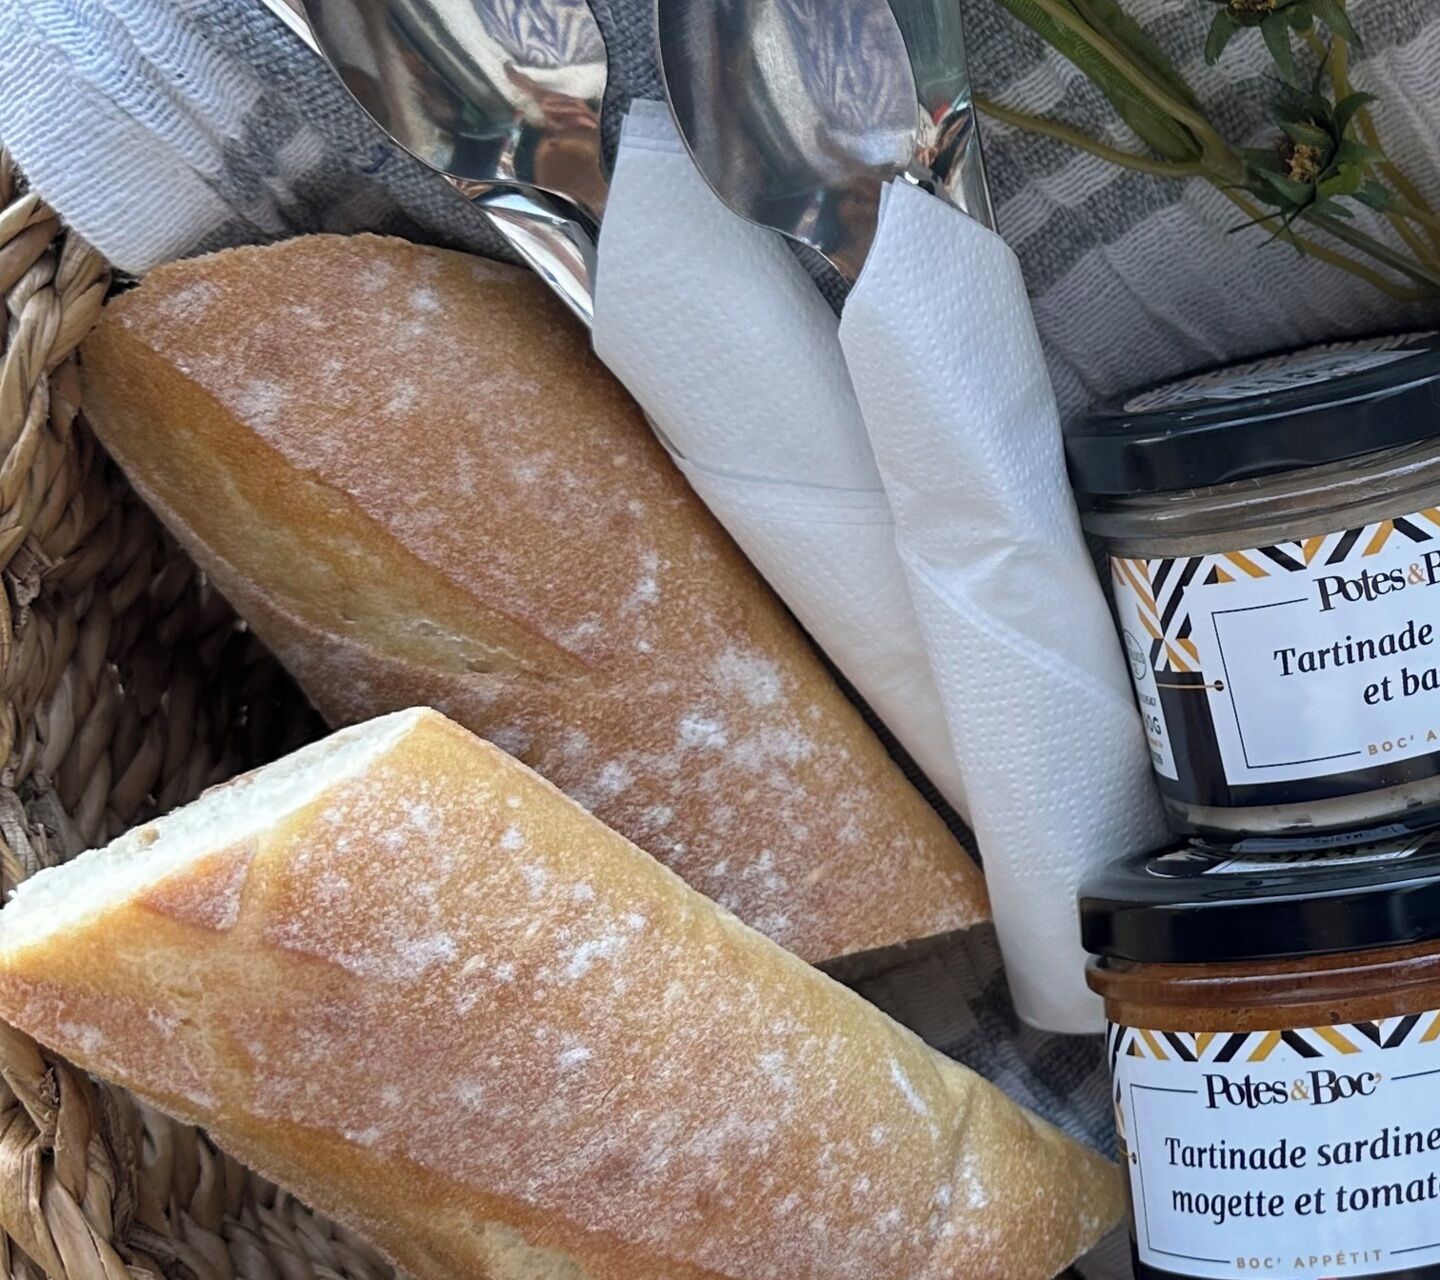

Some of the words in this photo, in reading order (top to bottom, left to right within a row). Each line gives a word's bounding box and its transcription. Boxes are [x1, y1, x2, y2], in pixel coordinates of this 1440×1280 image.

[1274, 621, 1434, 678] Tartinade
[1364, 677, 1393, 704] et
[1165, 1136, 1307, 1170] Tartinade
[1172, 1188, 1284, 1226] mogette
[1294, 1191, 1326, 1215] et
[1293, 1249, 1383, 1270] APPÉTIT
